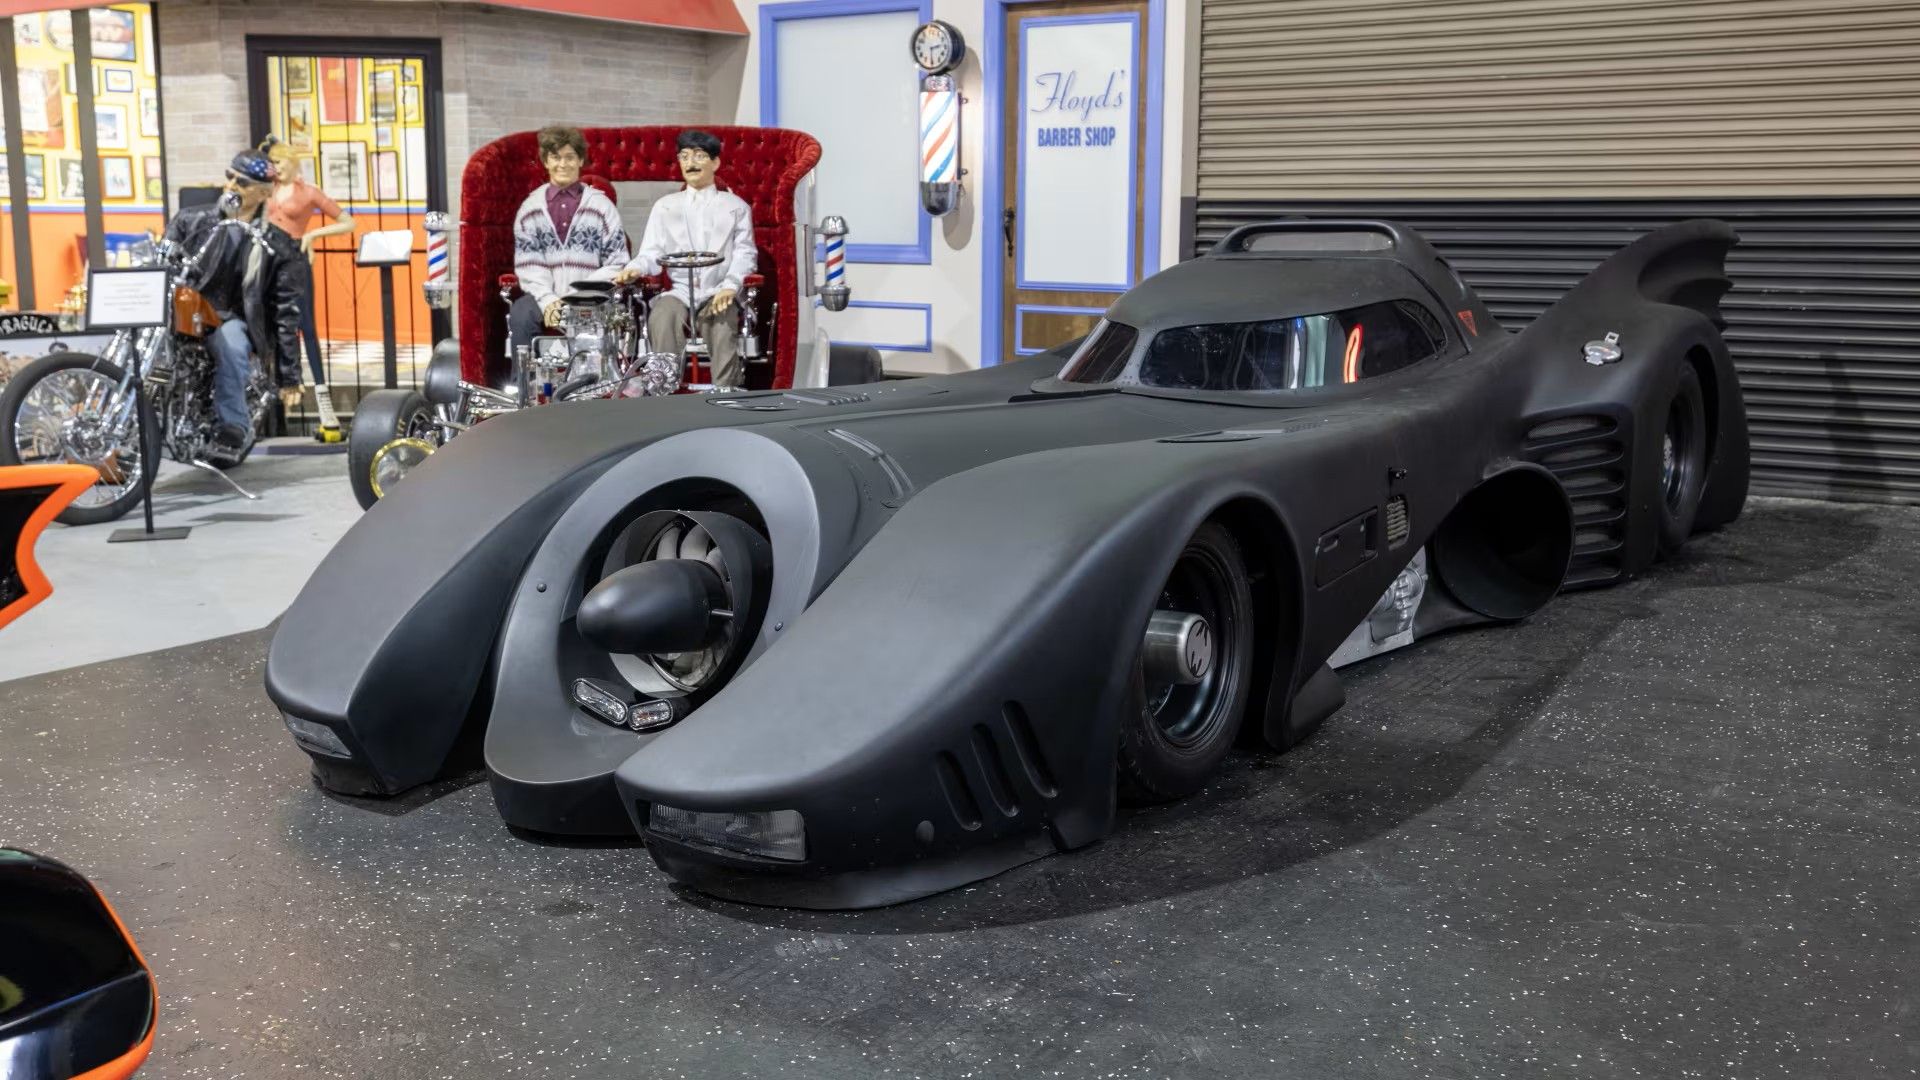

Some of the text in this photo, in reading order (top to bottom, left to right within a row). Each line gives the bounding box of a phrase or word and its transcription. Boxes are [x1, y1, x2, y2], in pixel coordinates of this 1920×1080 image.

[1031, 69, 1125, 122] Floyd's
[1037, 126, 1116, 147] BARBER SHOP
